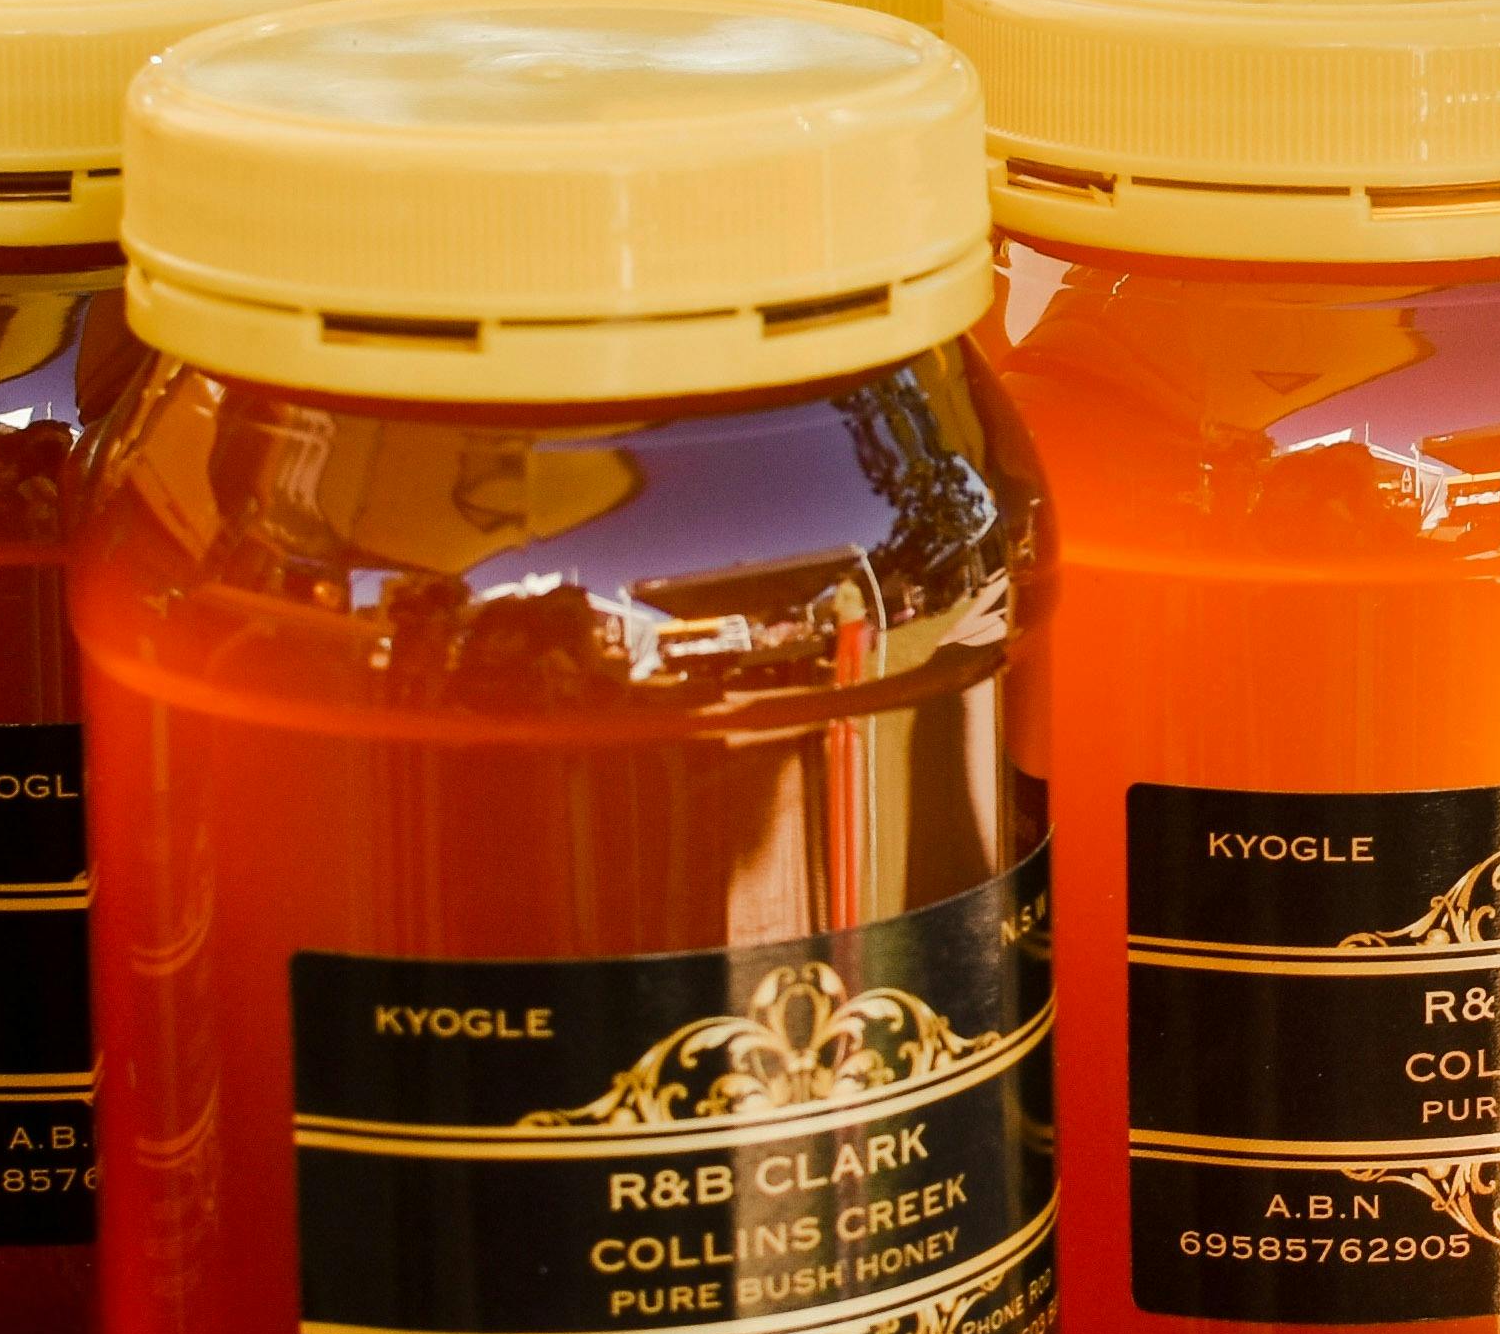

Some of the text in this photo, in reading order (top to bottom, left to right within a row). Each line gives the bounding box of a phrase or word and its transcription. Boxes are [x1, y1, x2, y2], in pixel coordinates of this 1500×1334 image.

[1208, 831, 1376, 862] KYOGLE
[375, 1005, 554, 1040] KYOGLE
[609, 1123, 929, 1212] R&B CLARK
[590, 1173, 968, 1275] COLLINS CREEK
[1266, 1194, 1379, 1221] A.B.N
[1179, 1231, 1471, 1262] 69585762905
[610, 1226, 960, 1317] PURE BUSH HONEY
